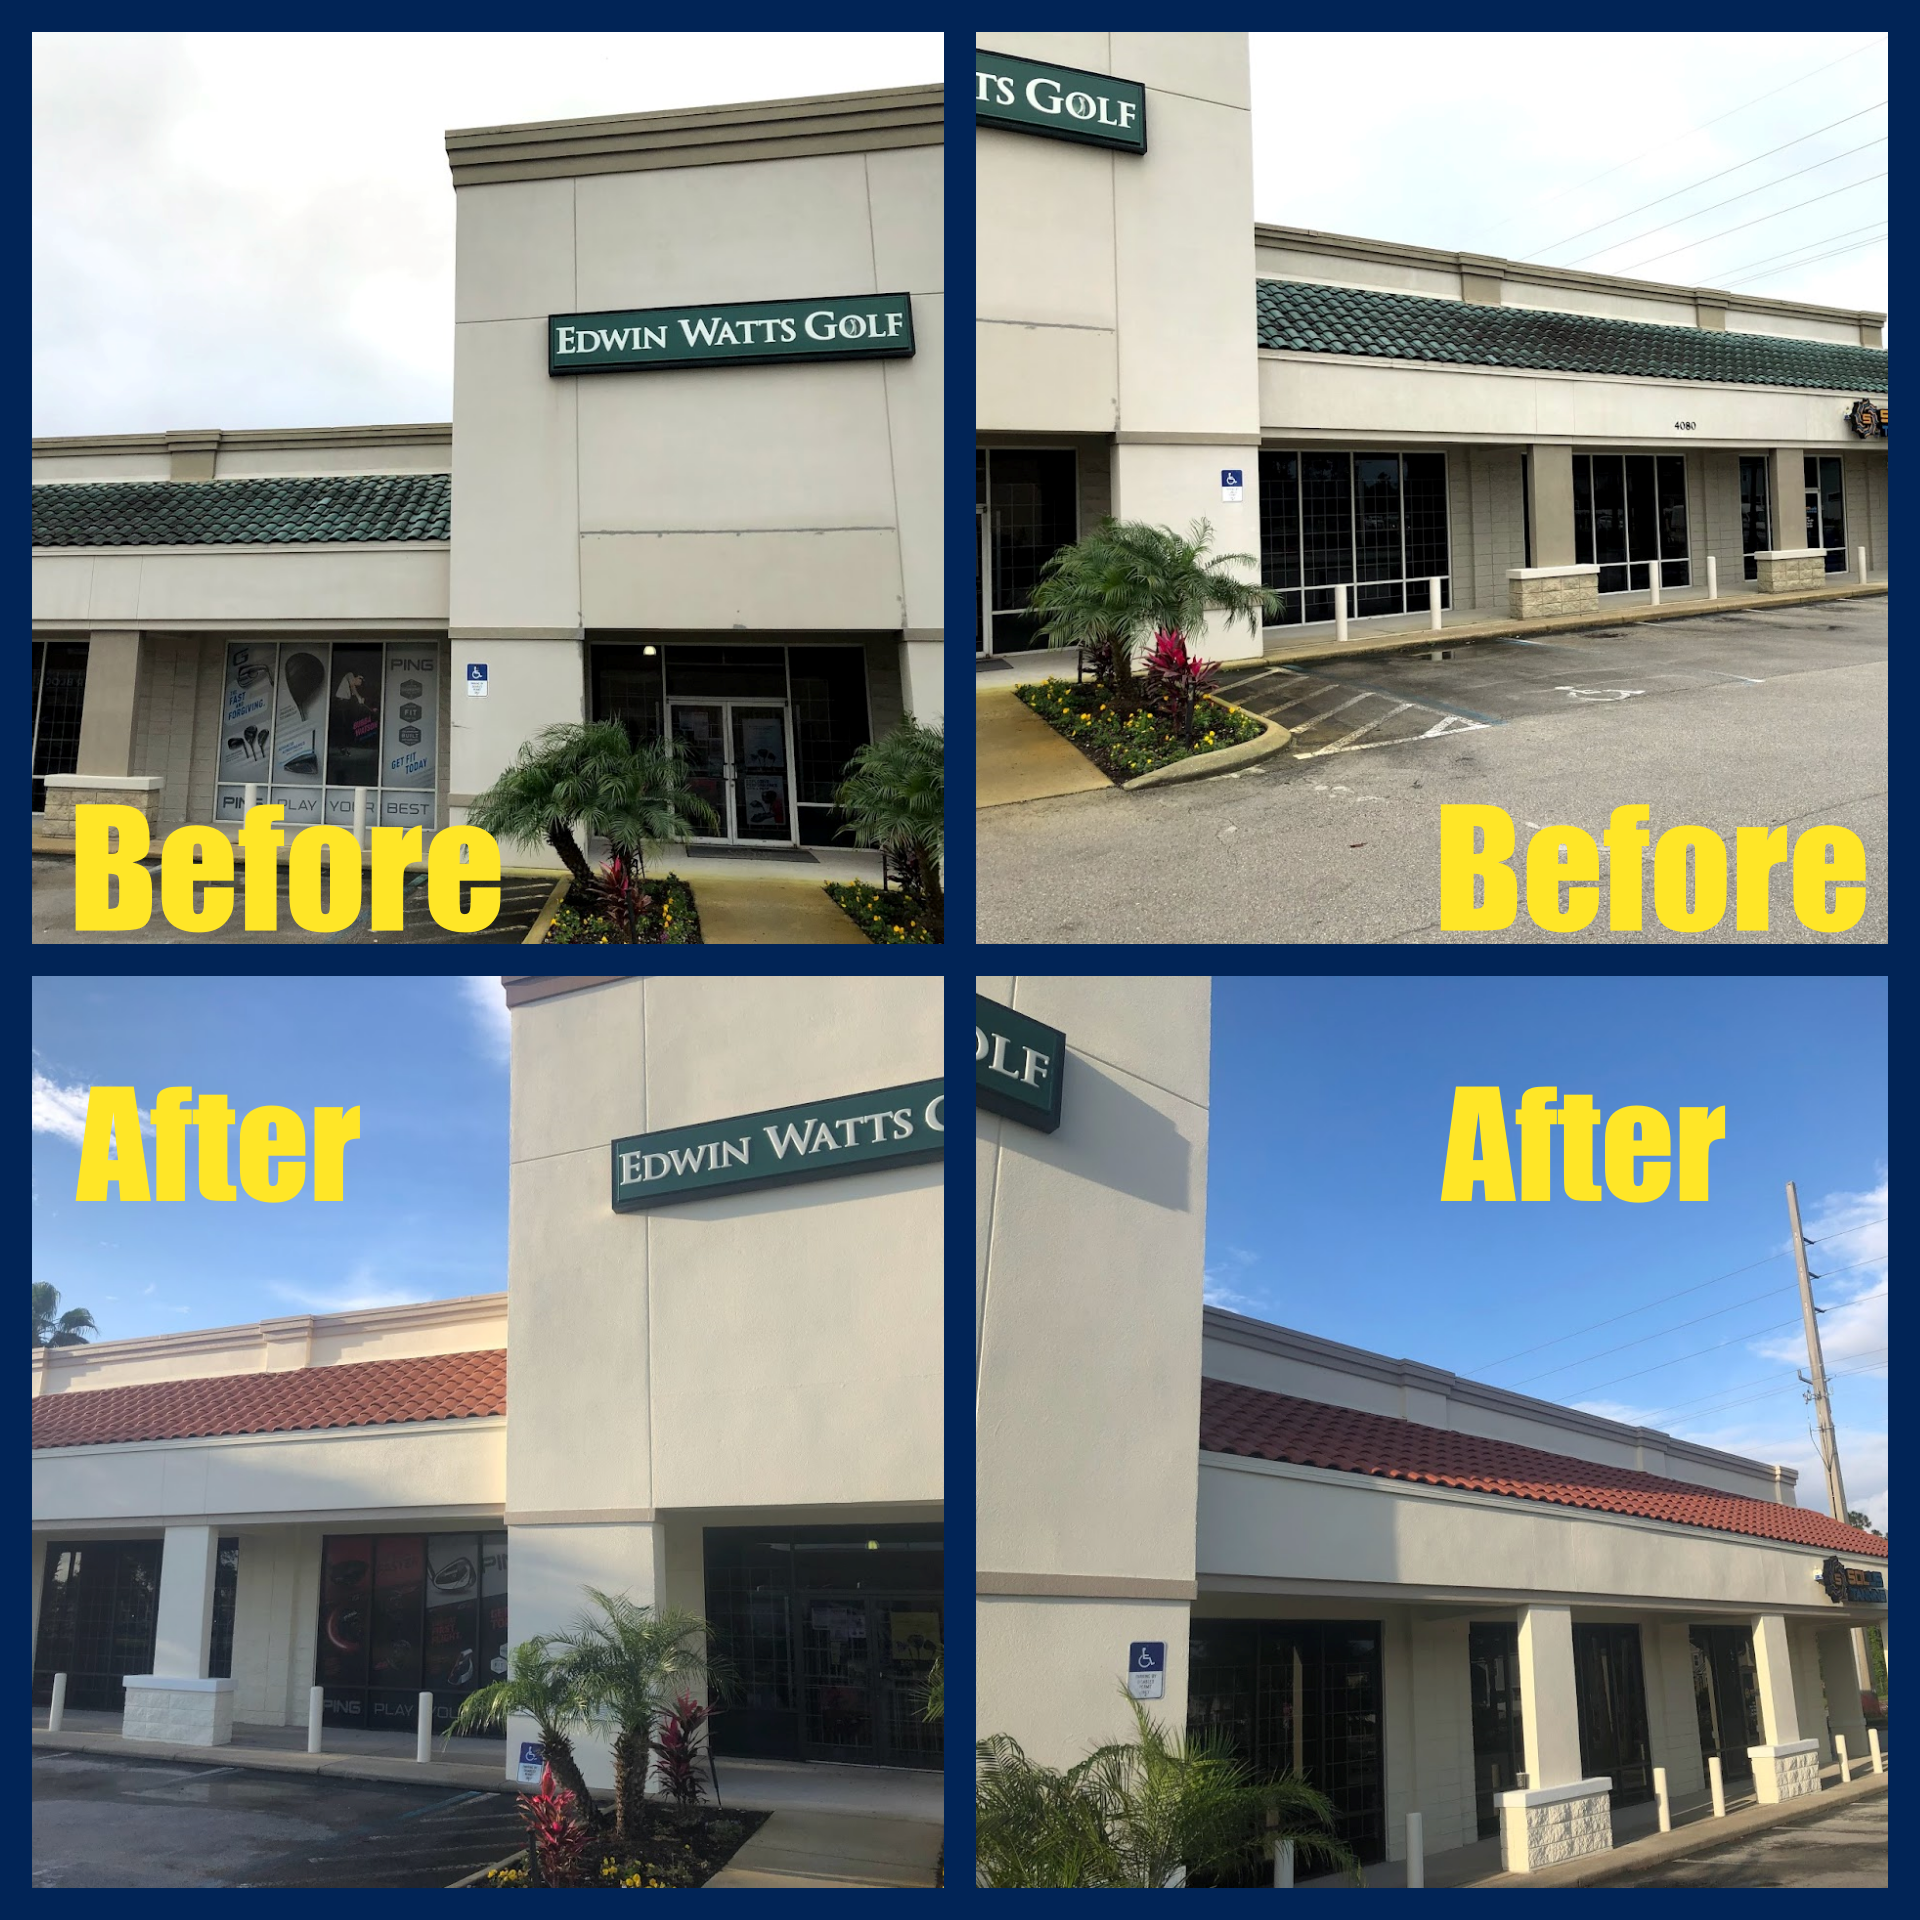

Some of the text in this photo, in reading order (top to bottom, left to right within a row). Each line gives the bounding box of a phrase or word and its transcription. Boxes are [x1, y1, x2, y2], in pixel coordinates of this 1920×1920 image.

[1025, 78, 1136, 129] GOLF
[556, 310, 903, 355] EDWIN WATTS GOLF
[1674, 421, 1697, 431] 4080
[391, 658, 434, 672] PING
[229, 691, 247, 706] FAST
[391, 751, 417, 770] GET FIT
[405, 757, 428, 775] TODAY
[329, 800, 376, 813] YOR
[387, 802, 430, 815] BEST
[619, 1136, 752, 1186] EDWIN
[763, 1108, 914, 1160] WATTS
[374, 1703, 414, 1717] PLAY
